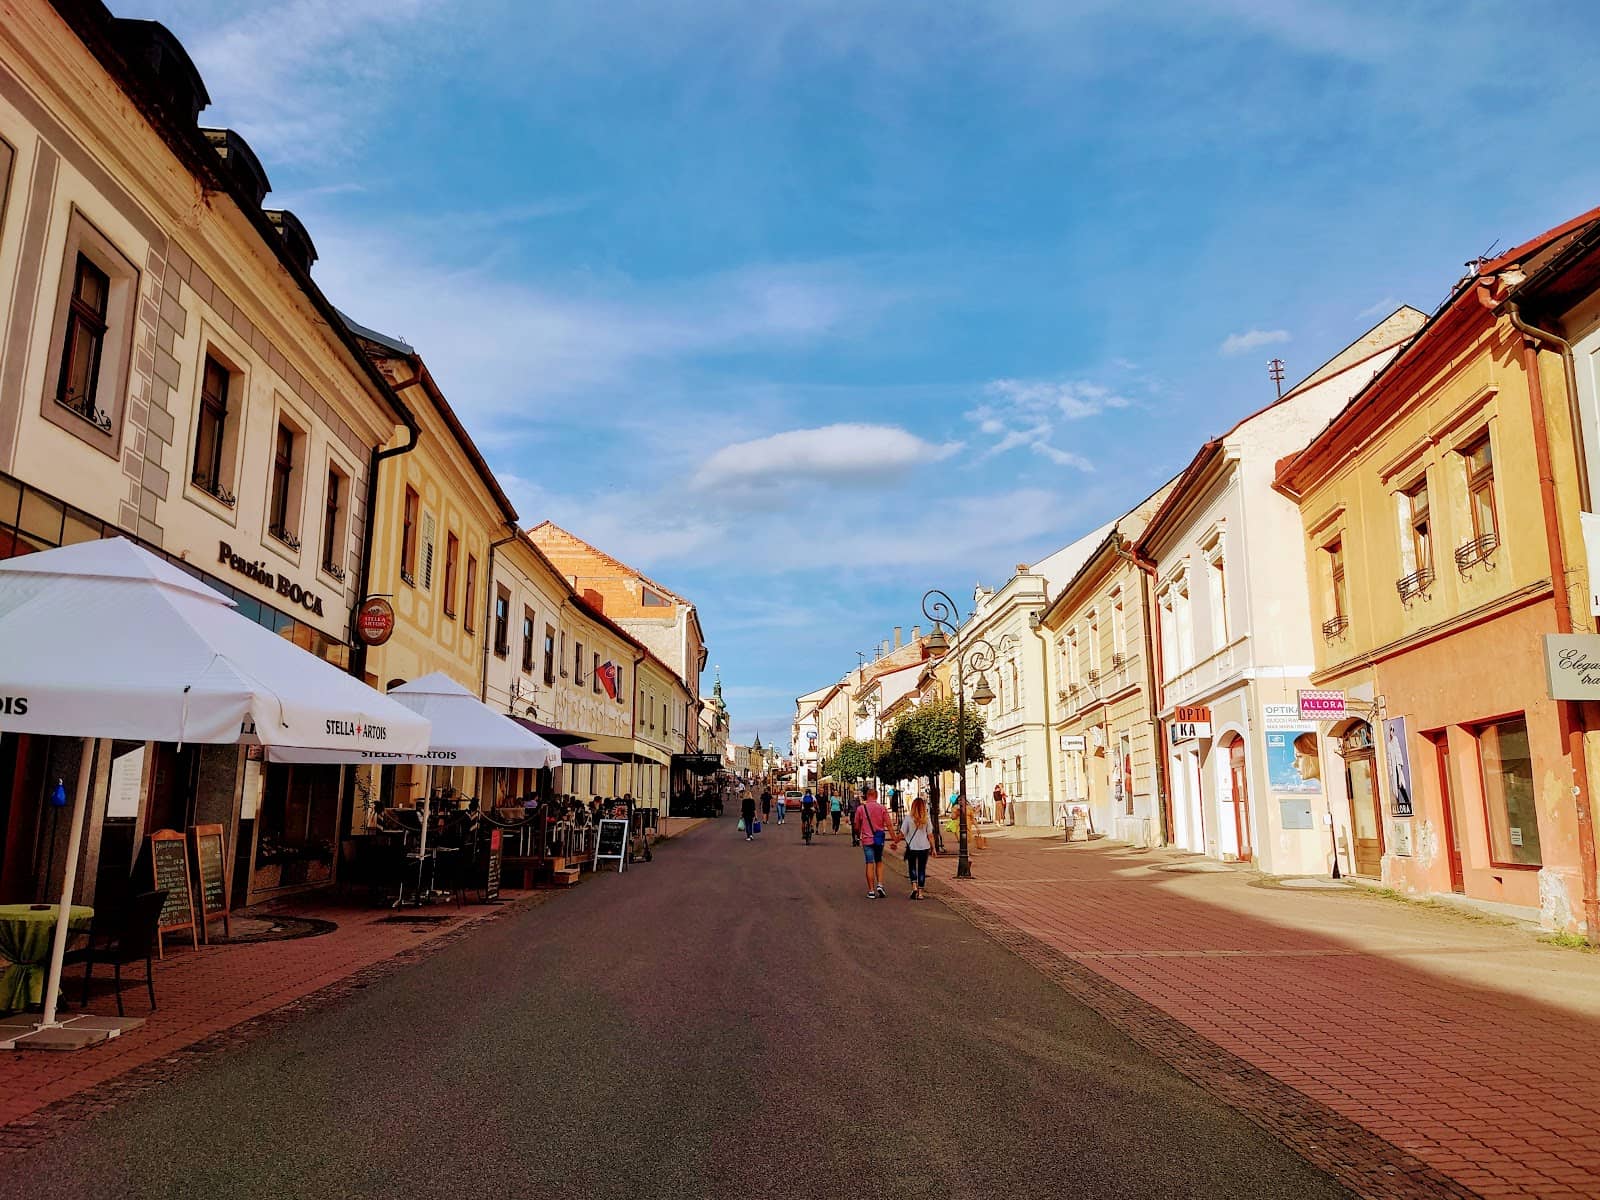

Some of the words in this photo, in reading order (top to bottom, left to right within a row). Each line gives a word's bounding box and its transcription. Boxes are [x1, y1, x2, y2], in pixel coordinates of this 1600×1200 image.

[218, 540, 274, 589] Penzión
[276, 573, 323, 617] BOCA
[1558, 648, 1600, 676] Elega
[0, 696, 28, 715] IS
[1180, 708, 1206, 720] OPTI
[1303, 700, 1343, 709] ALLORA
[326, 719, 355, 736] STELLA
[363, 723, 386, 740] ARTOIS
[1180, 724, 1196, 736] KA
